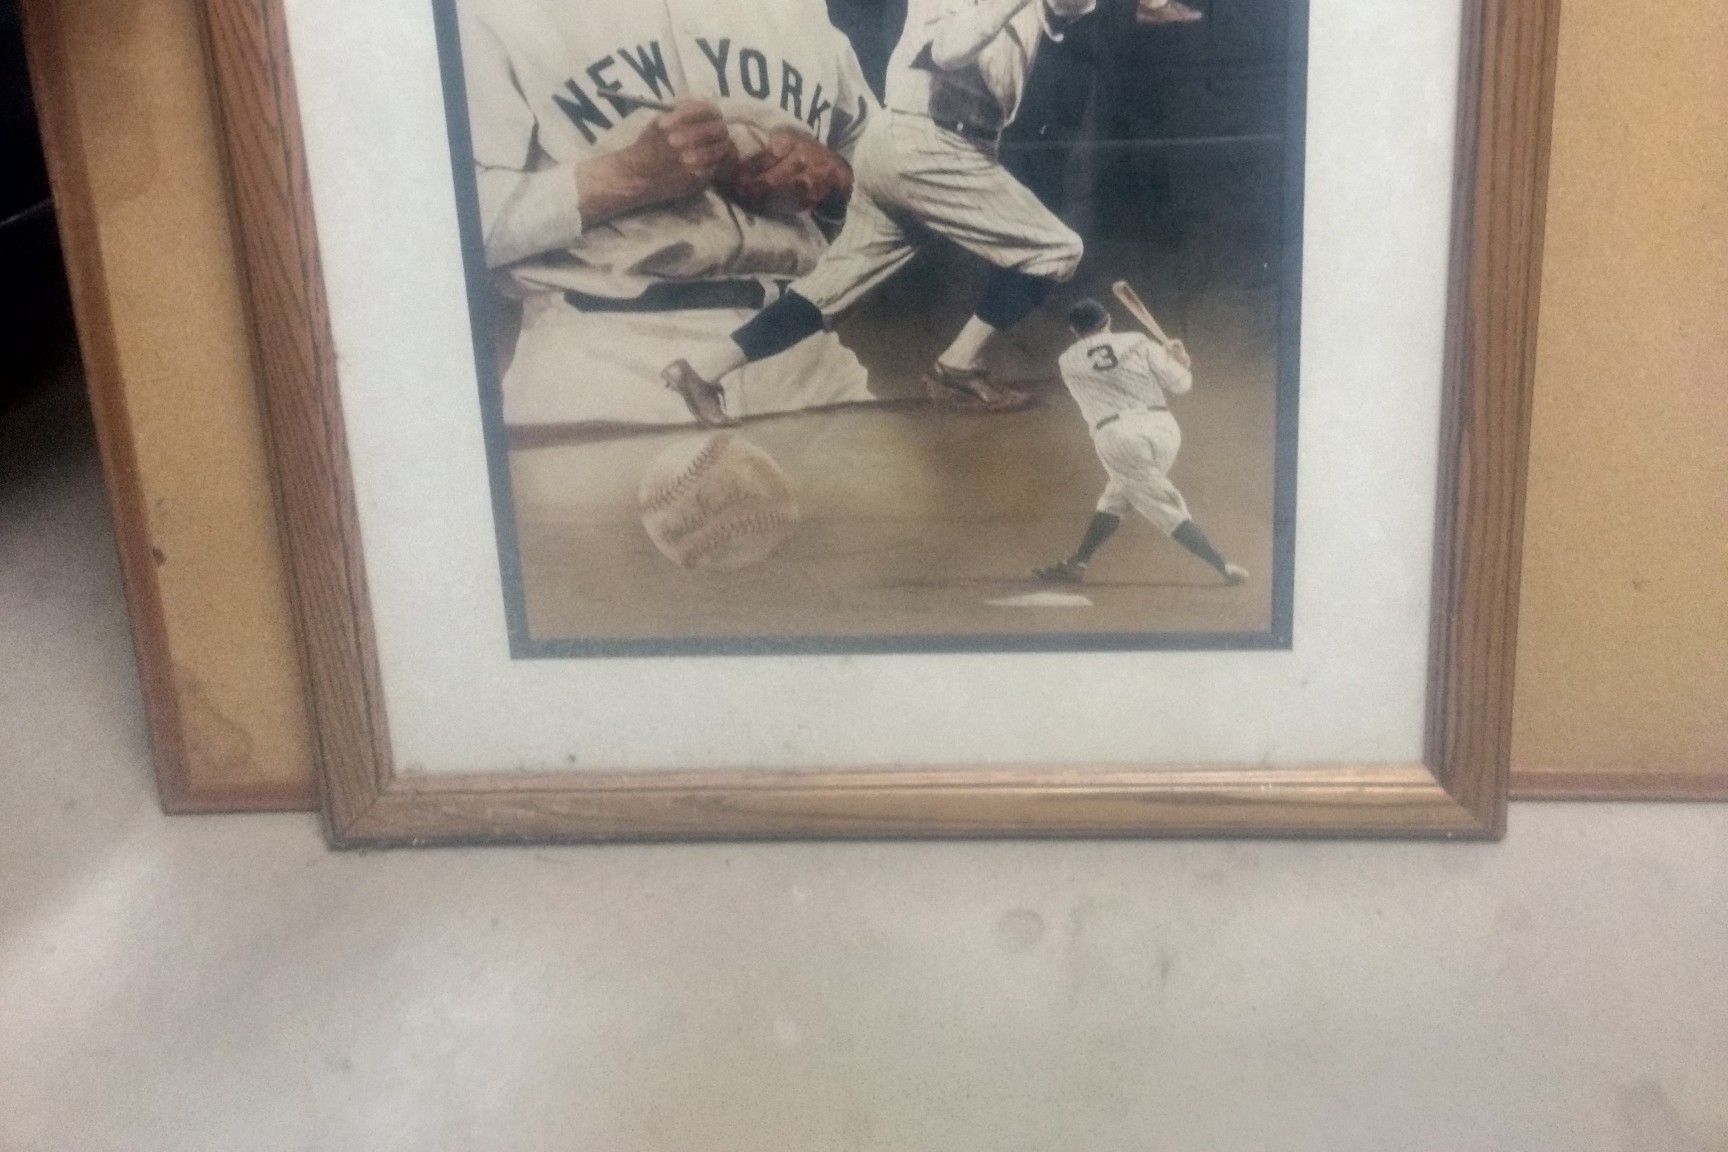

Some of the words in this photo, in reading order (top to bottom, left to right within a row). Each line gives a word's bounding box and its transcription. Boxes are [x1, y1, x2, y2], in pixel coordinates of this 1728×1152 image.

[551, 40, 675, 145] NEW
[695, 37, 831, 140] YORK
[1087, 344, 1118, 371] 3
